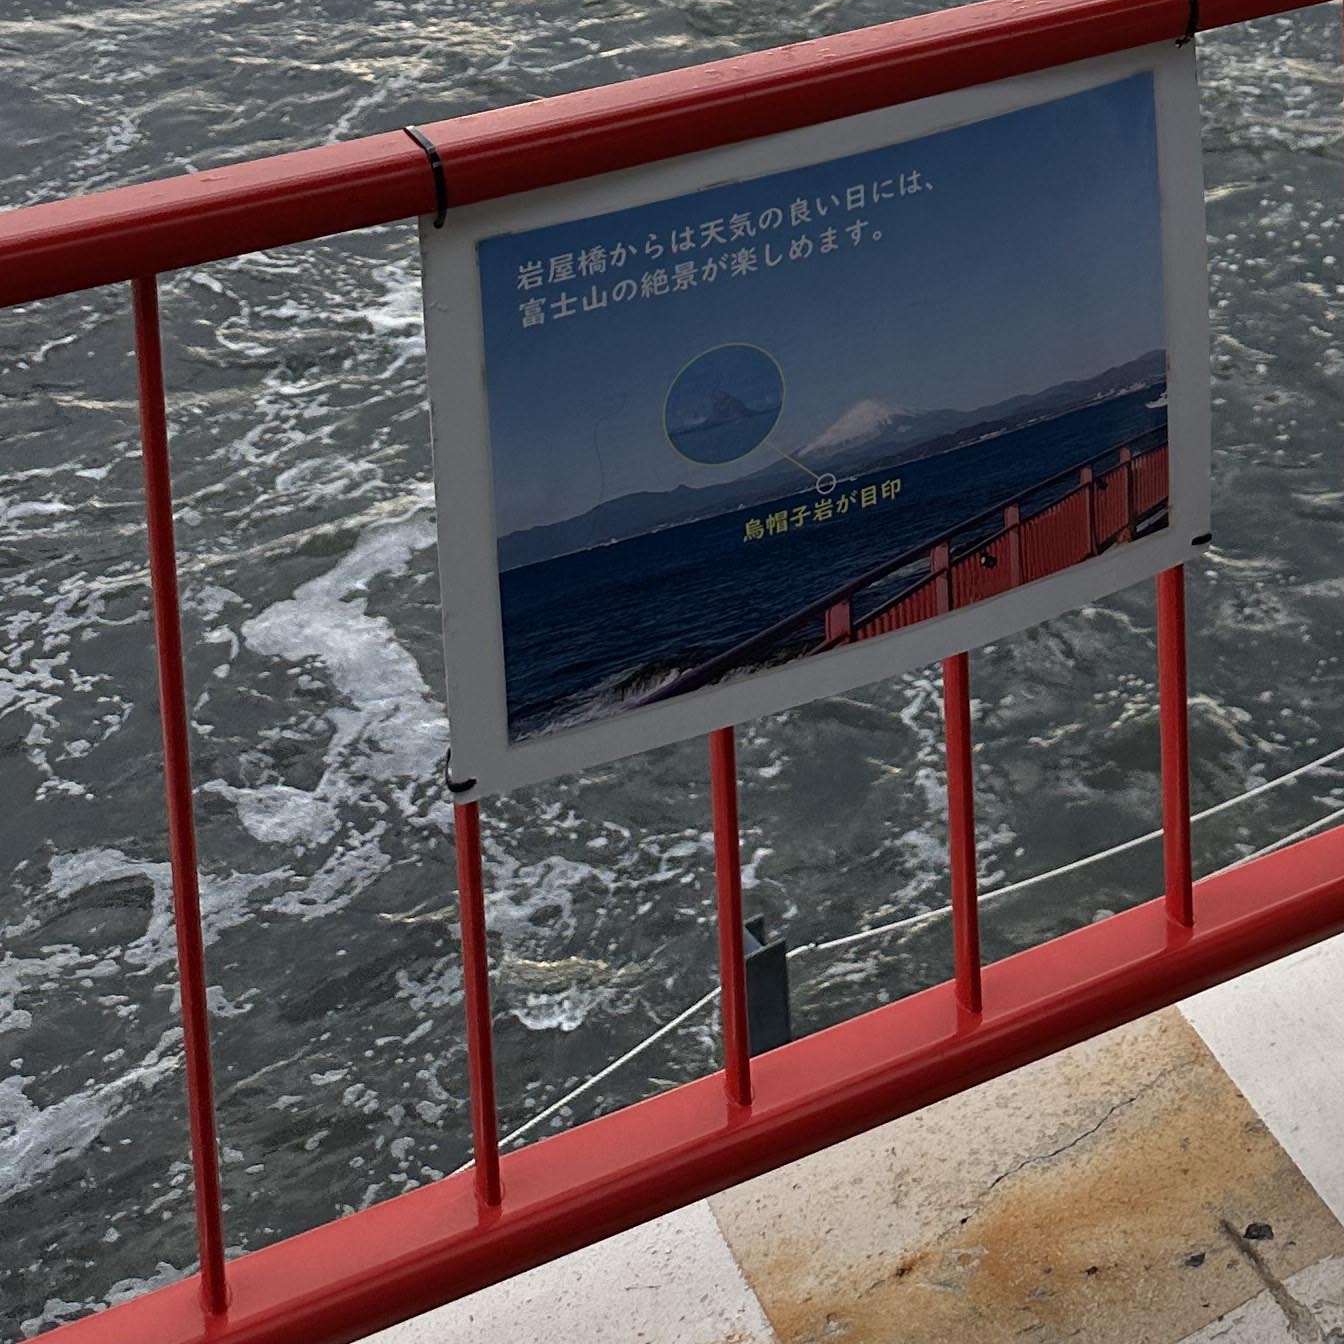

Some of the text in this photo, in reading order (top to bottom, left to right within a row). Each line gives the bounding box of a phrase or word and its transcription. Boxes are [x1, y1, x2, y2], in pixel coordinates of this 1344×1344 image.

[515, 168, 936, 291] 岩屋橋からは天気の良い日には、
[517, 218, 885, 329] 富士山の絶景が楽しめます。
